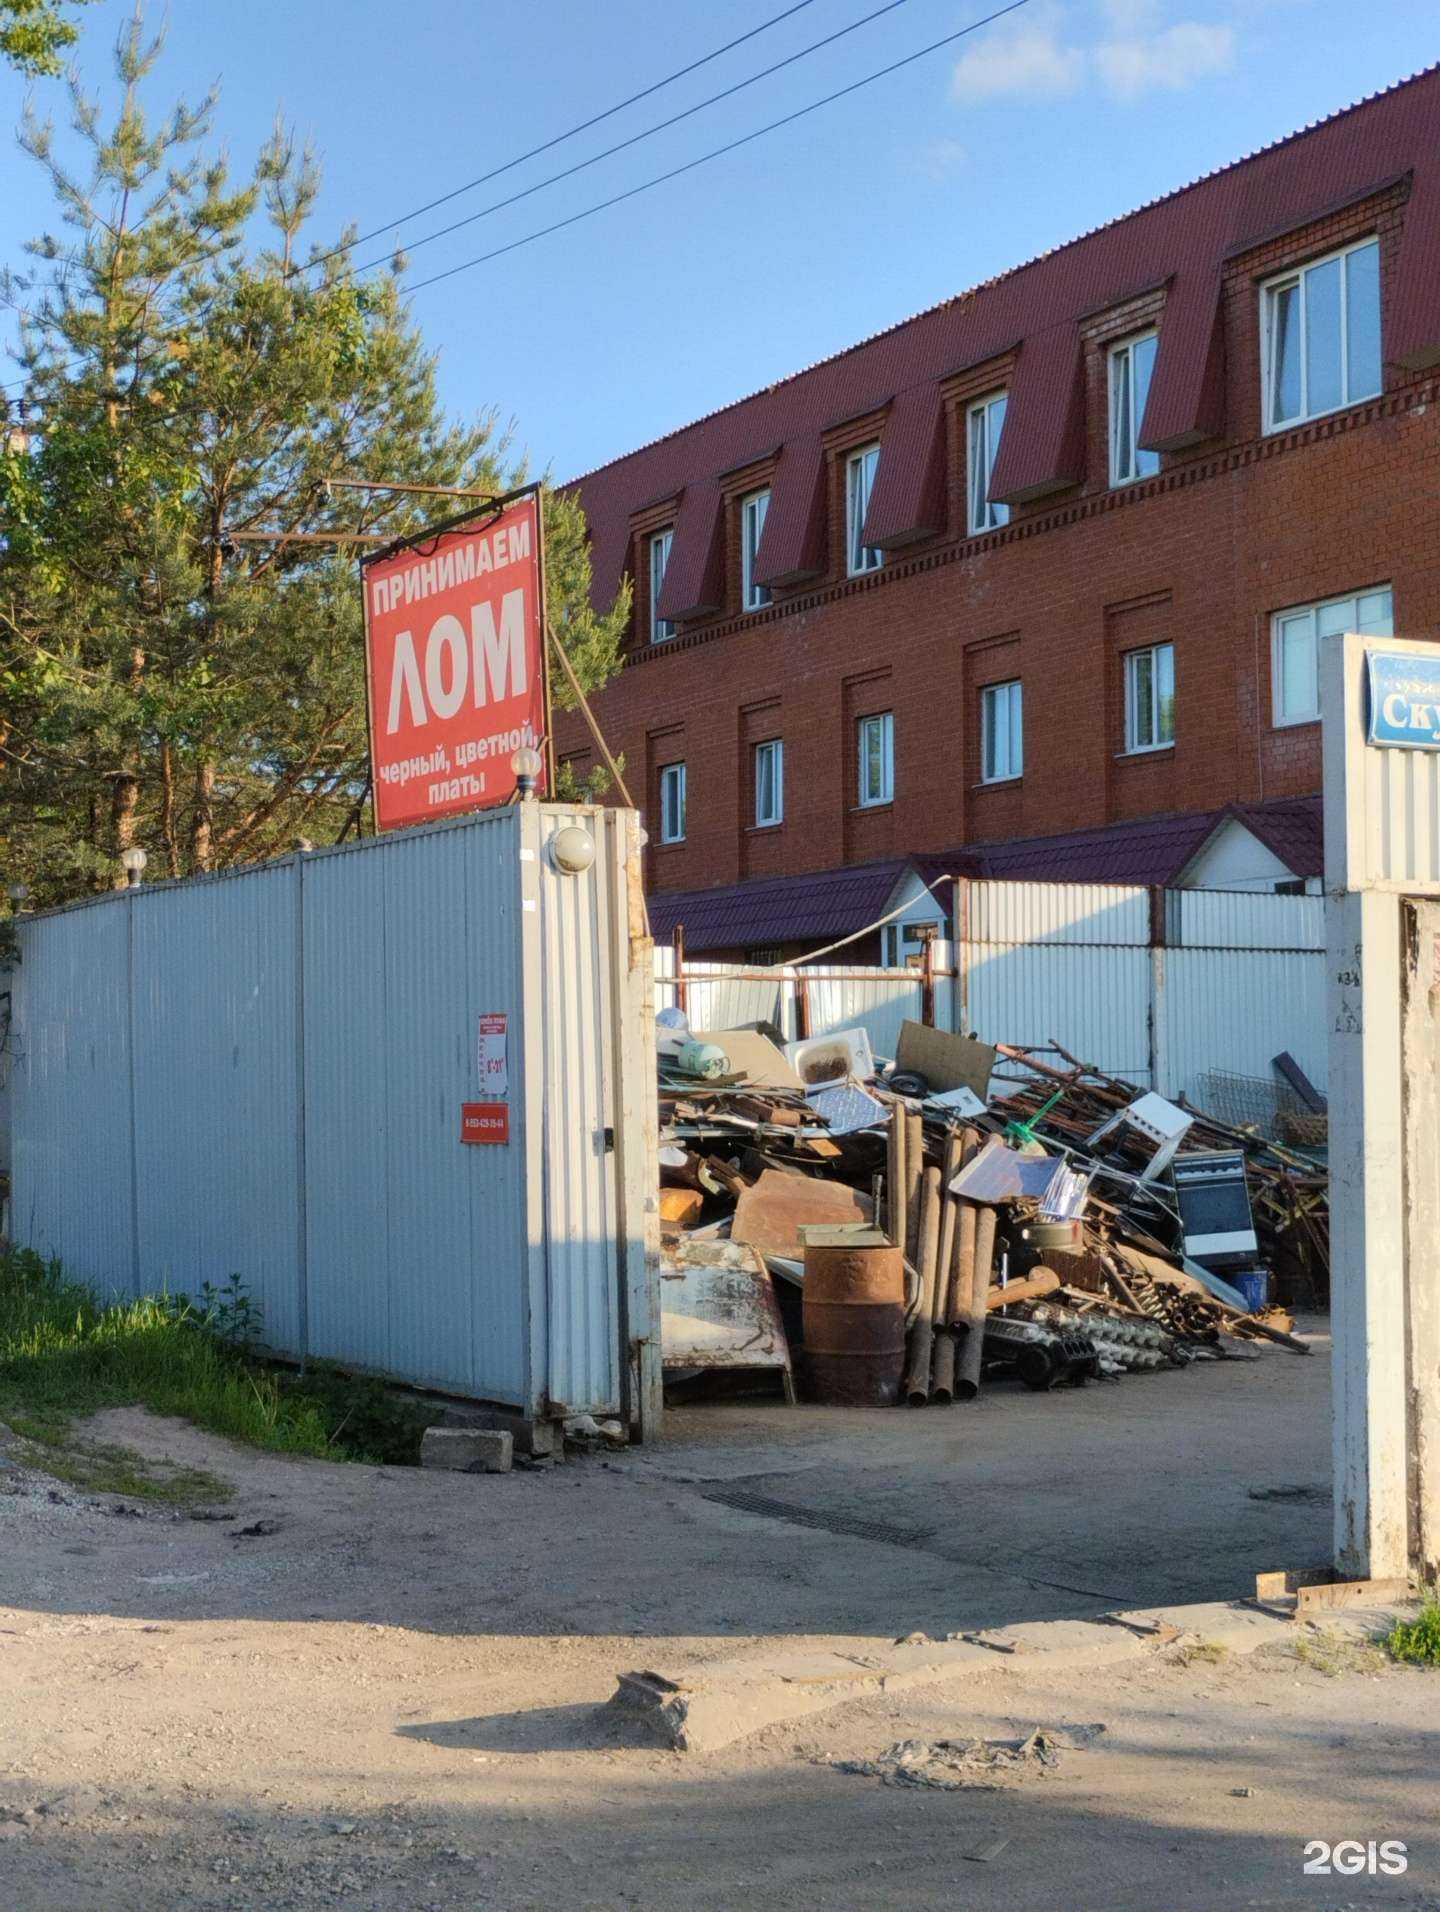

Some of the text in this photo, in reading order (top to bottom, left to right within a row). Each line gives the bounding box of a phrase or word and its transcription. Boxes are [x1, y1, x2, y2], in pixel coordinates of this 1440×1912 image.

[373, 520, 530, 617] ПРИНИМАЕМ
[386, 587, 528, 736] ЛОМ
[379, 744, 451, 786] черный,
[428, 771, 486, 805] платы
